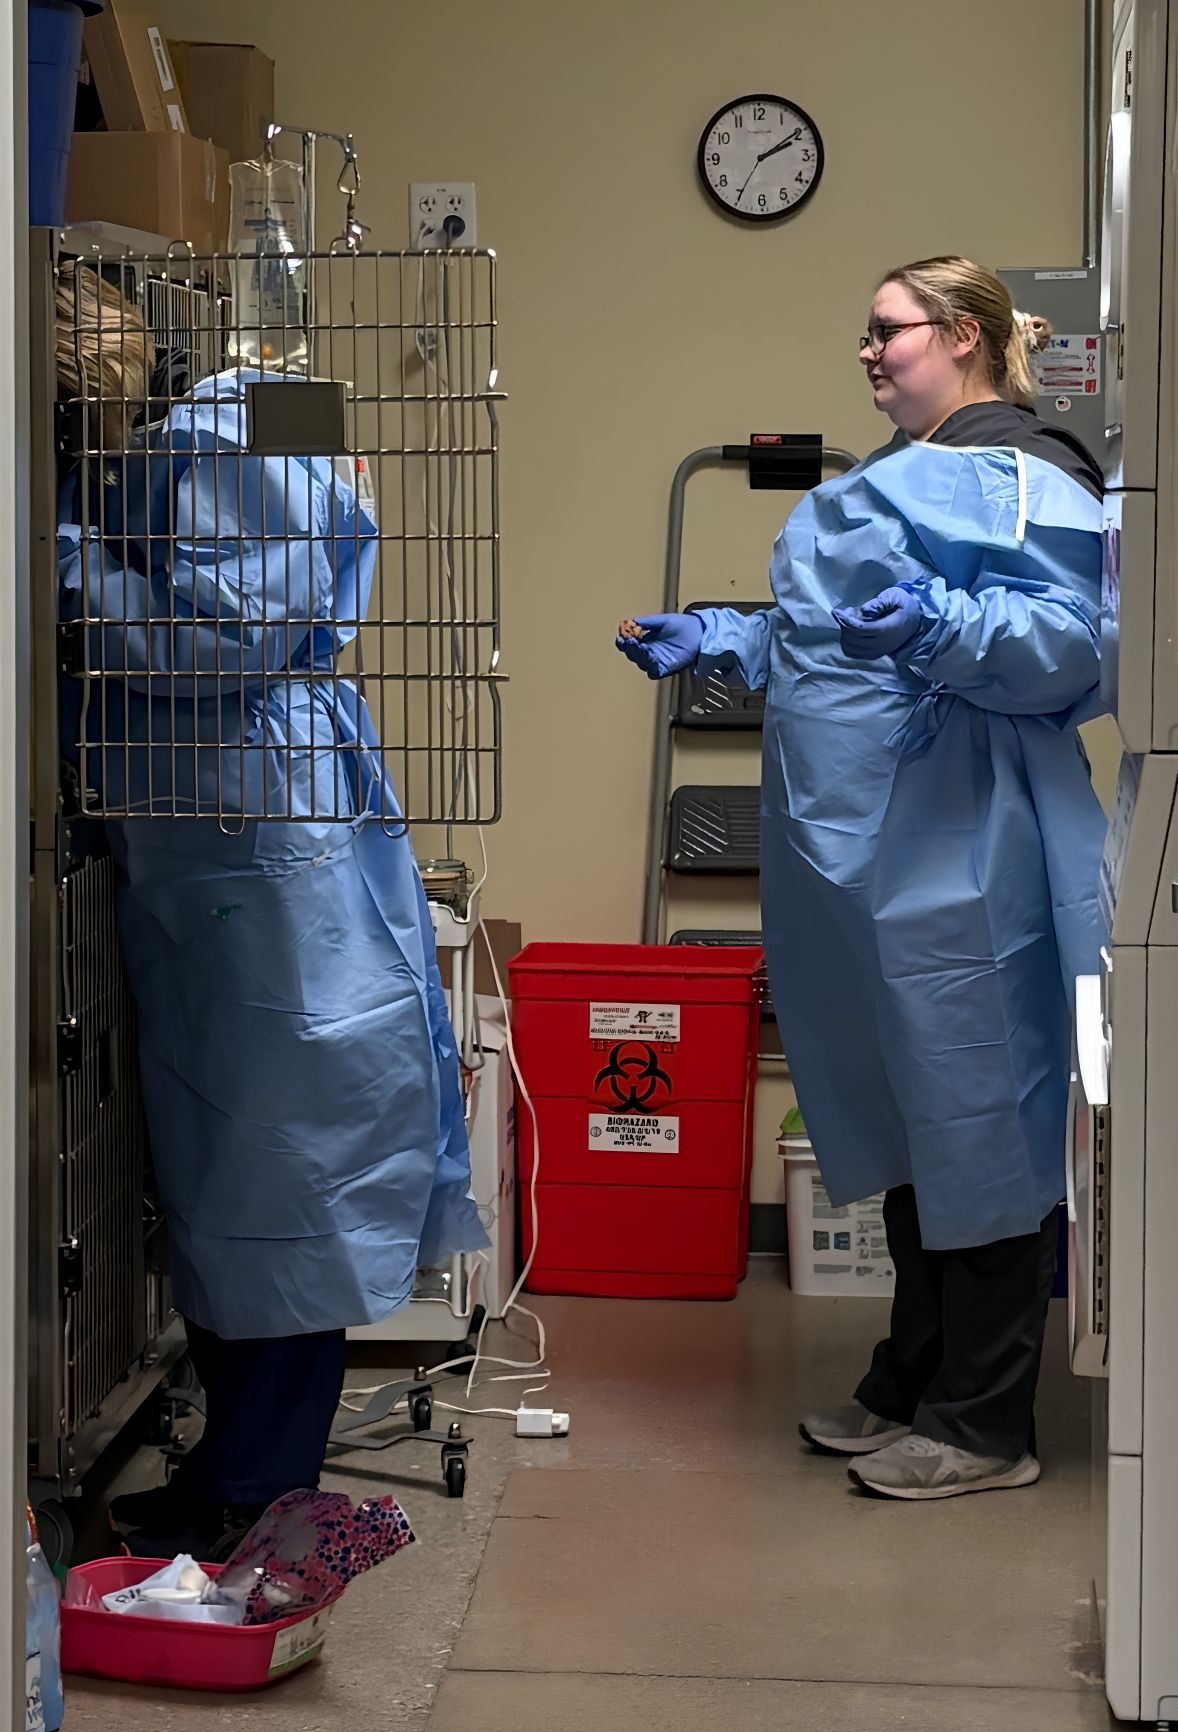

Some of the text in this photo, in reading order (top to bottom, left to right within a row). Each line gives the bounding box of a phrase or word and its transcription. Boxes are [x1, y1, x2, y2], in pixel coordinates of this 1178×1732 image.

[735, 114, 743, 128] 11
[753, 107, 765, 121] 12
[718, 131, 730, 145] 10
[711, 152, 720, 165] 9
[801, 149, 811, 162] 3
[719, 174, 728, 187] 8
[795, 170, 804, 184] 4
[758, 193, 766, 207] 6
[779, 187, 788, 201] 5
[607, 1116, 659, 1127] BIOHAZARD
